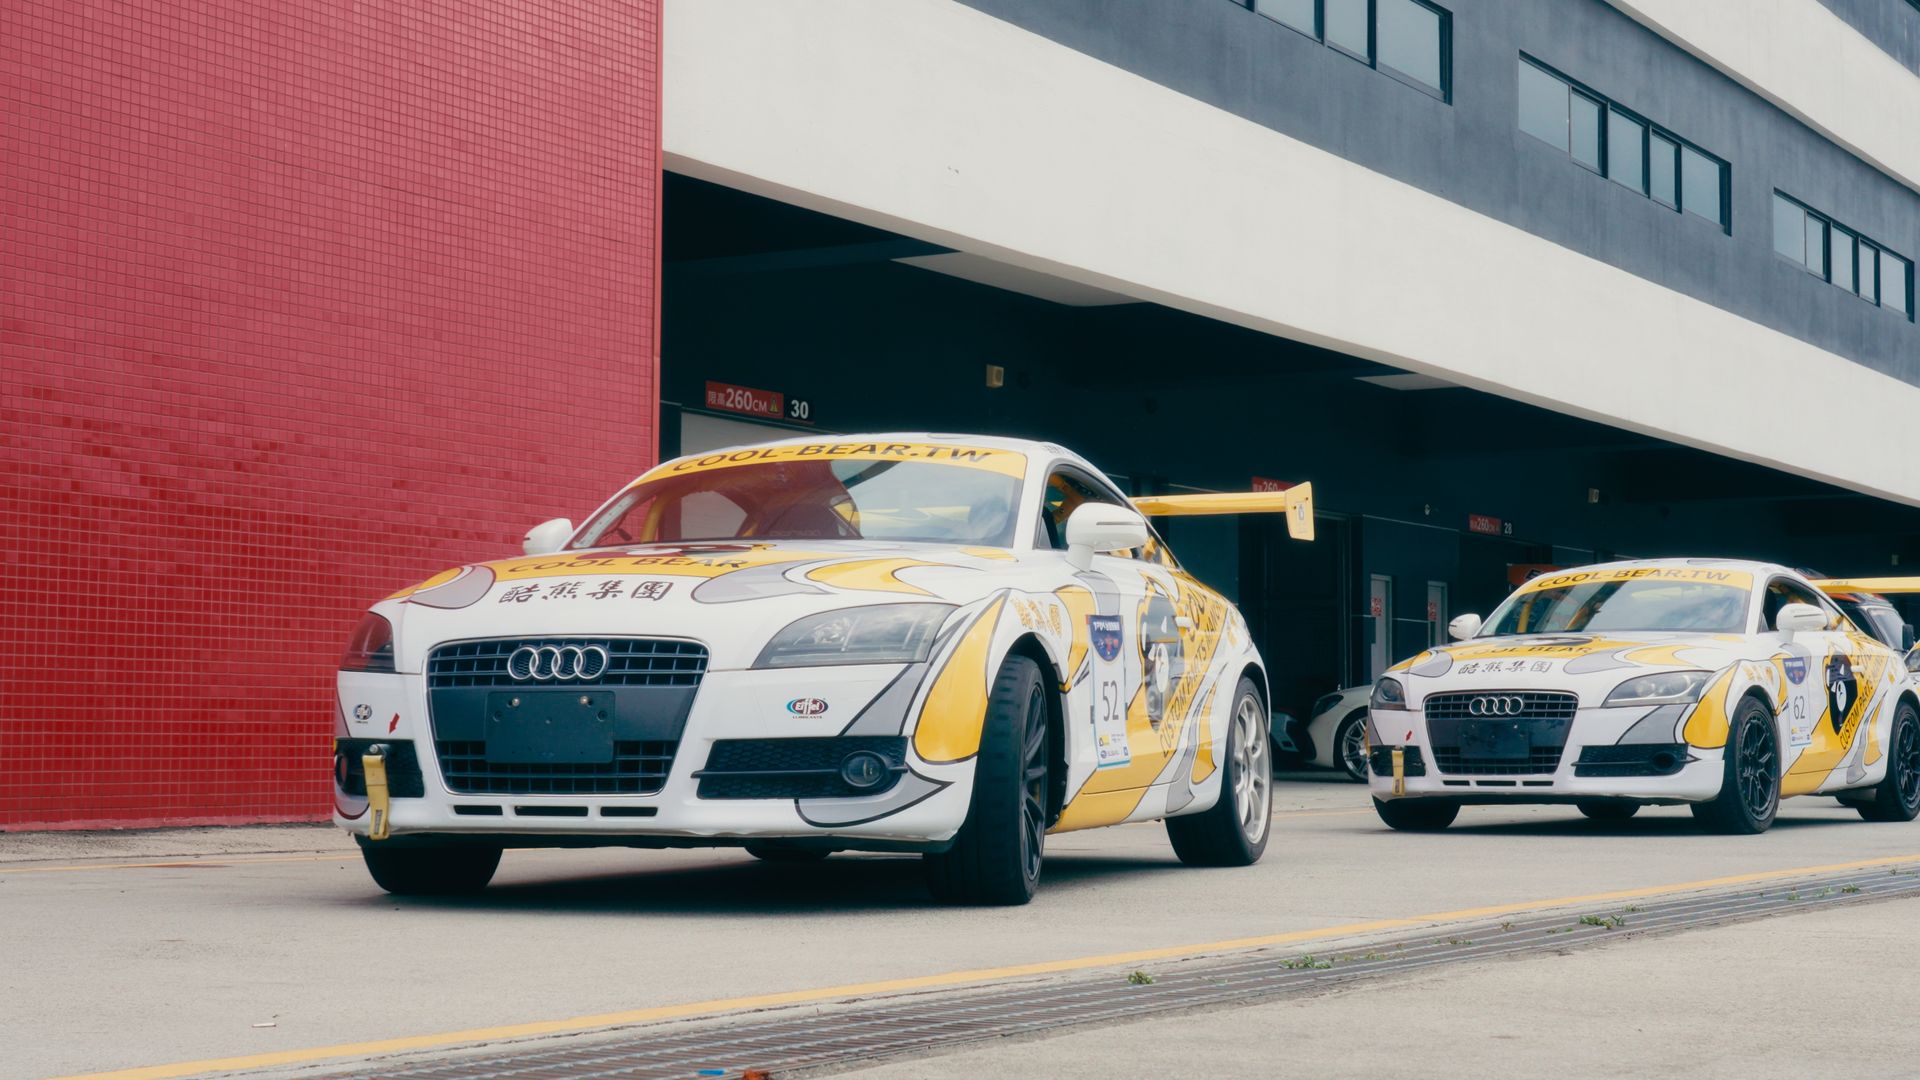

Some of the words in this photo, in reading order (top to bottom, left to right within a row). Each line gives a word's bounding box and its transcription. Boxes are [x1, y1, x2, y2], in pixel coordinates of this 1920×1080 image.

[791, 400, 808, 418] 30
[672, 443, 993, 472] COOL-BEAR.TW
[1504, 522, 1513, 535] 28
[507, 558, 616, 573] COOL
[630, 557, 749, 569] BEAR
[1537, 568, 1732, 588] COOL-BEAR.TW
[499, 580, 674, 604] 酷熊集團
[1102, 680, 1120, 721] 52
[1793, 695, 1806, 720] 62
[1159, 685, 1187, 758] CUSTOM
[1839, 705, 1860, 750] CUSTOM
